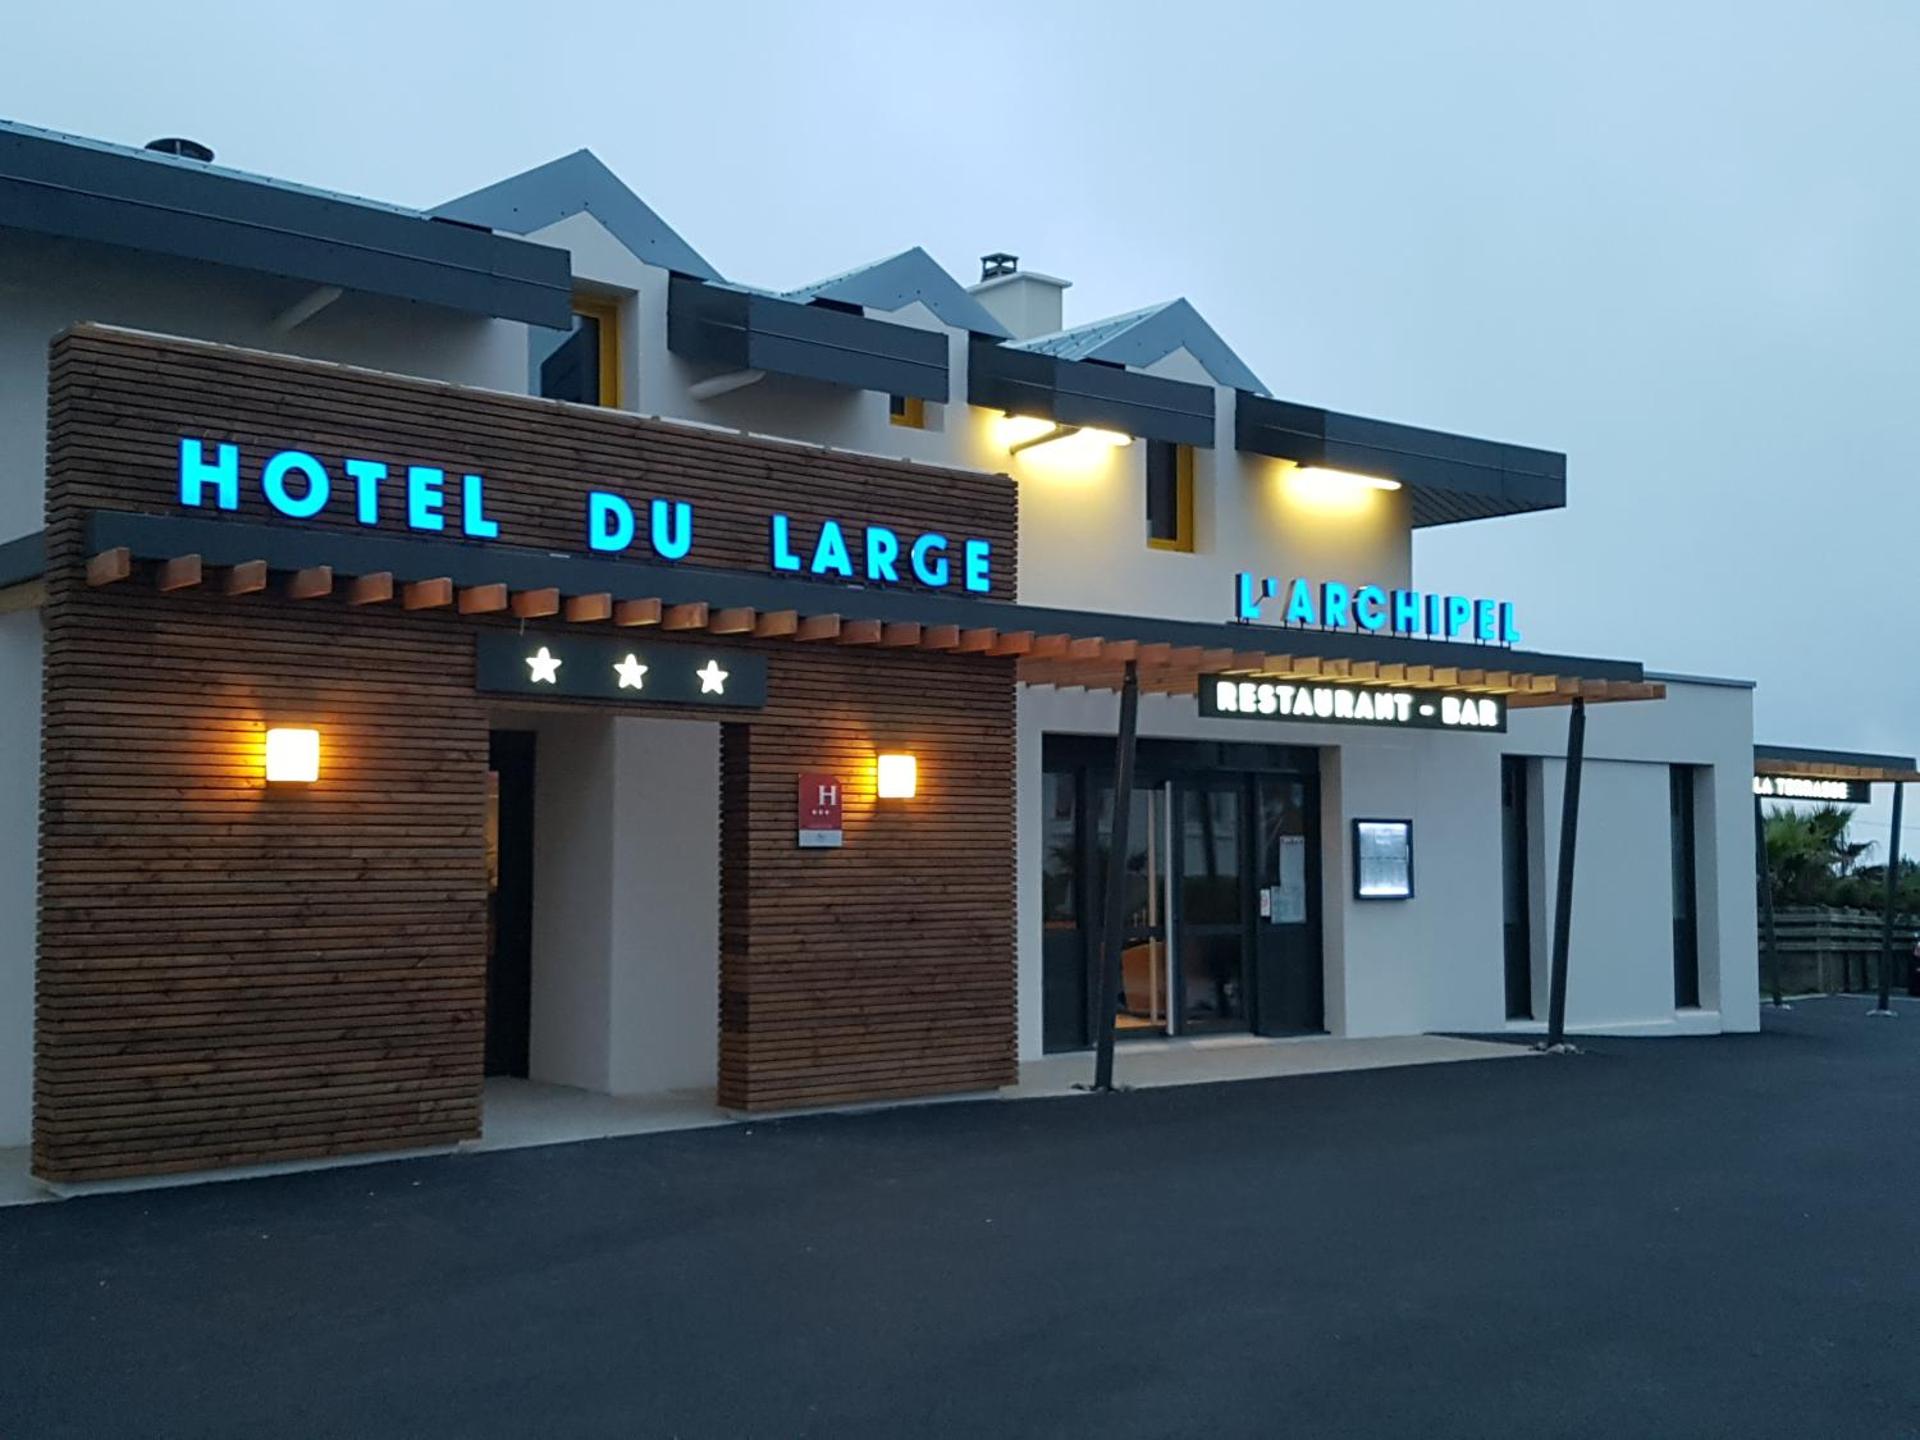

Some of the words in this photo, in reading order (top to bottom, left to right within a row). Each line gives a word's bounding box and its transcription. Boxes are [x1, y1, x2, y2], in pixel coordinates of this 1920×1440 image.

[180, 438, 499, 538] HOTEL
[590, 491, 693, 559] DU
[772, 514, 991, 593] LARGE
[1236, 570, 1521, 647] L'ARCHIPEL
[1216, 681, 1413, 722] RESTAURANT
[1441, 696, 1499, 728] BAR
[818, 784, 837, 806] H
